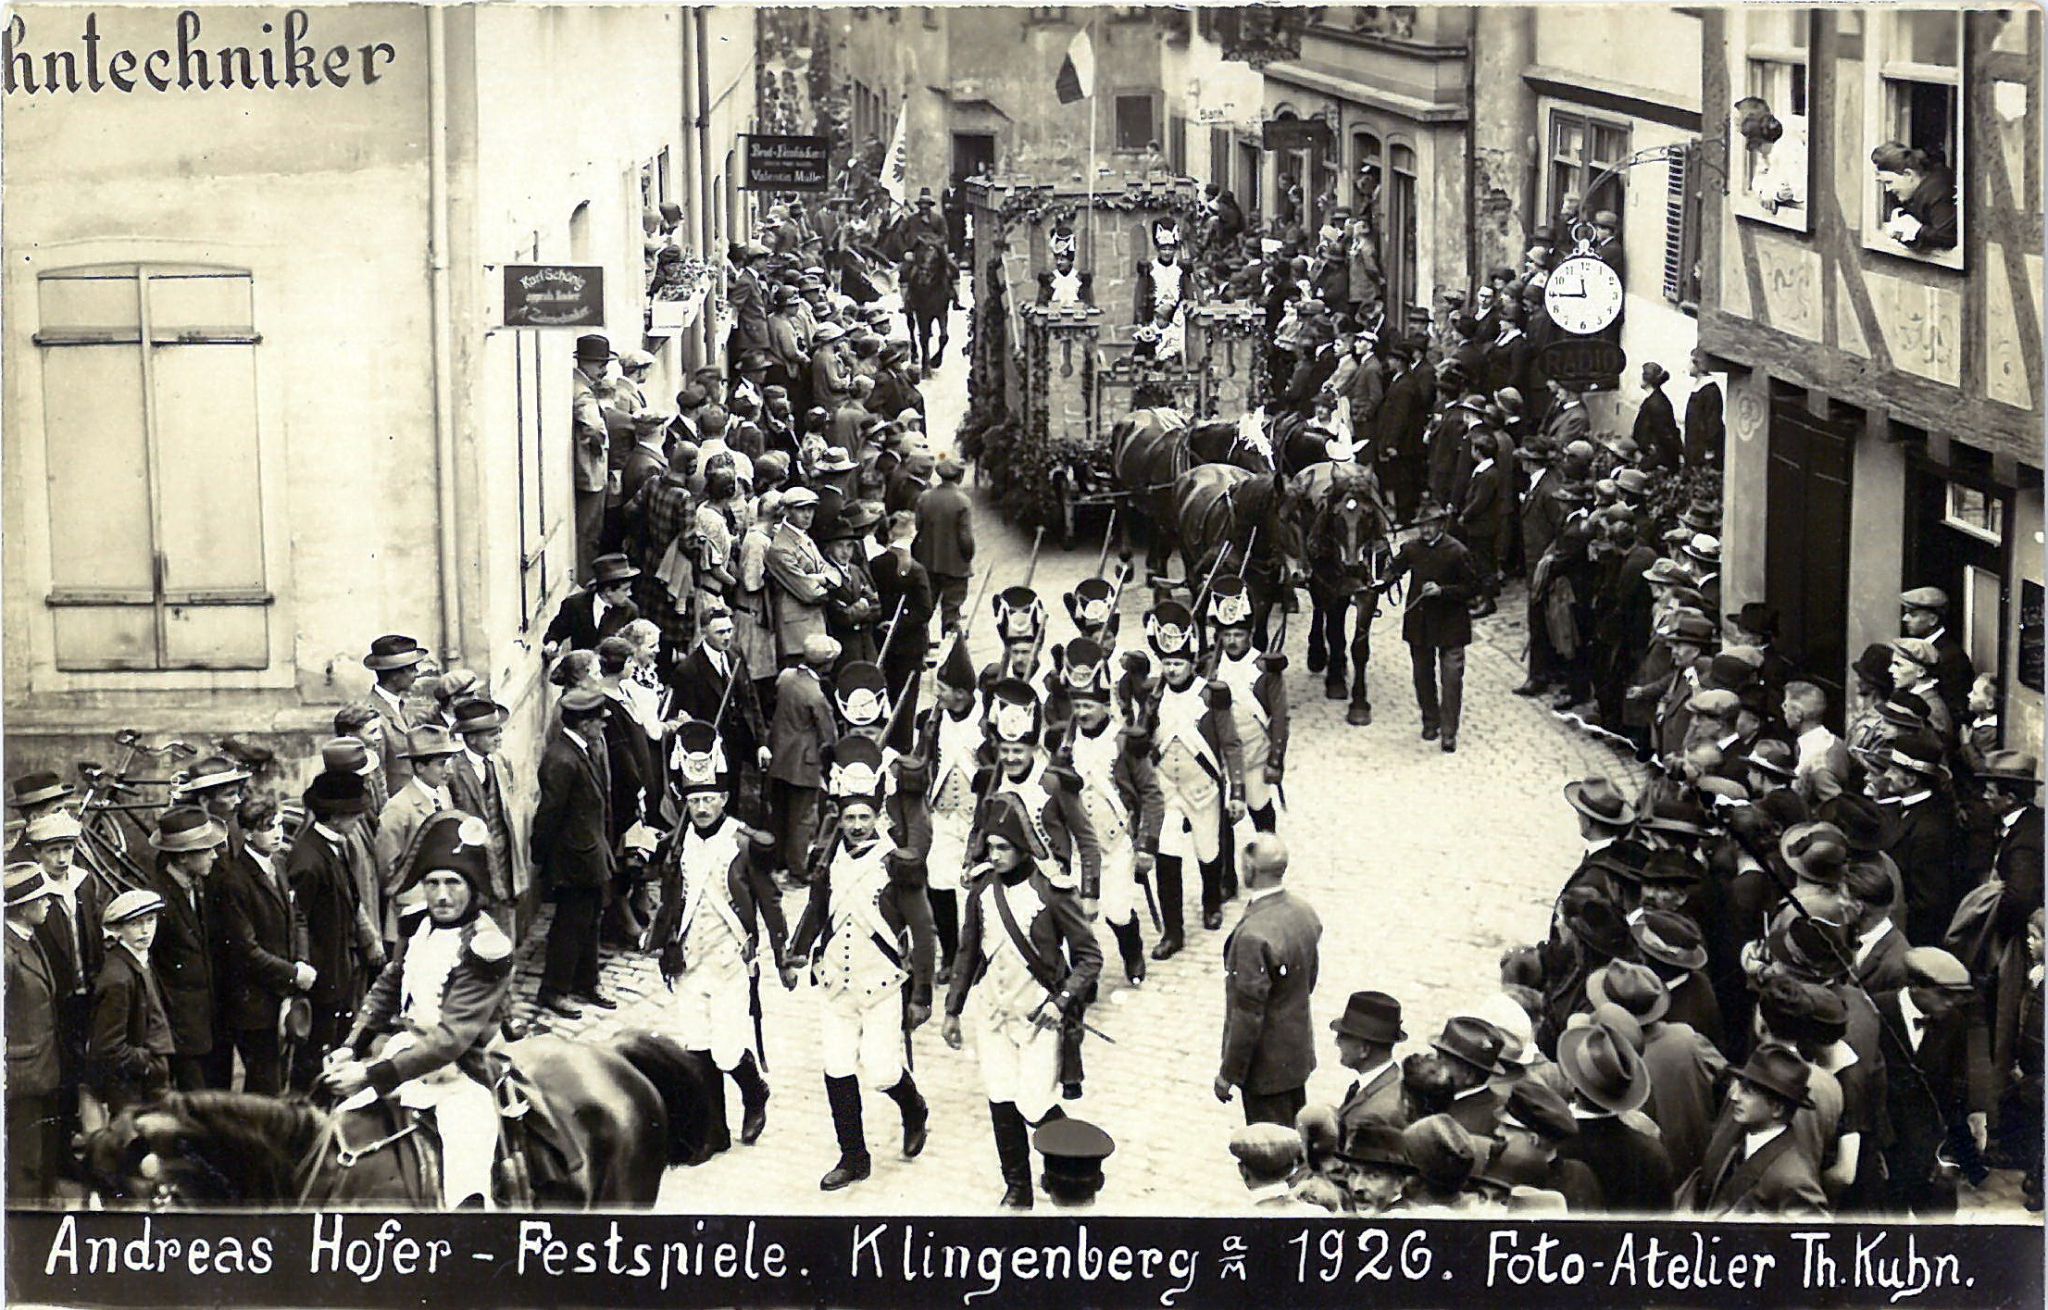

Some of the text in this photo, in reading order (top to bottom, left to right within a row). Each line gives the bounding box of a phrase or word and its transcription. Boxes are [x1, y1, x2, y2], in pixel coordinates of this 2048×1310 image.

[1565, 266, 1574, 276] 11
[1581, 262, 1591, 271] 12
[1555, 276, 1565, 286] 10
[1612, 291, 1618, 301] 3
[1553, 305, 1560, 314] 8
[1607, 305, 1613, 315] 4
[1580, 321, 1587, 330] 6
[1597, 316, 1603, 326] 5
[1545, 348, 1618, 374] RADIO
